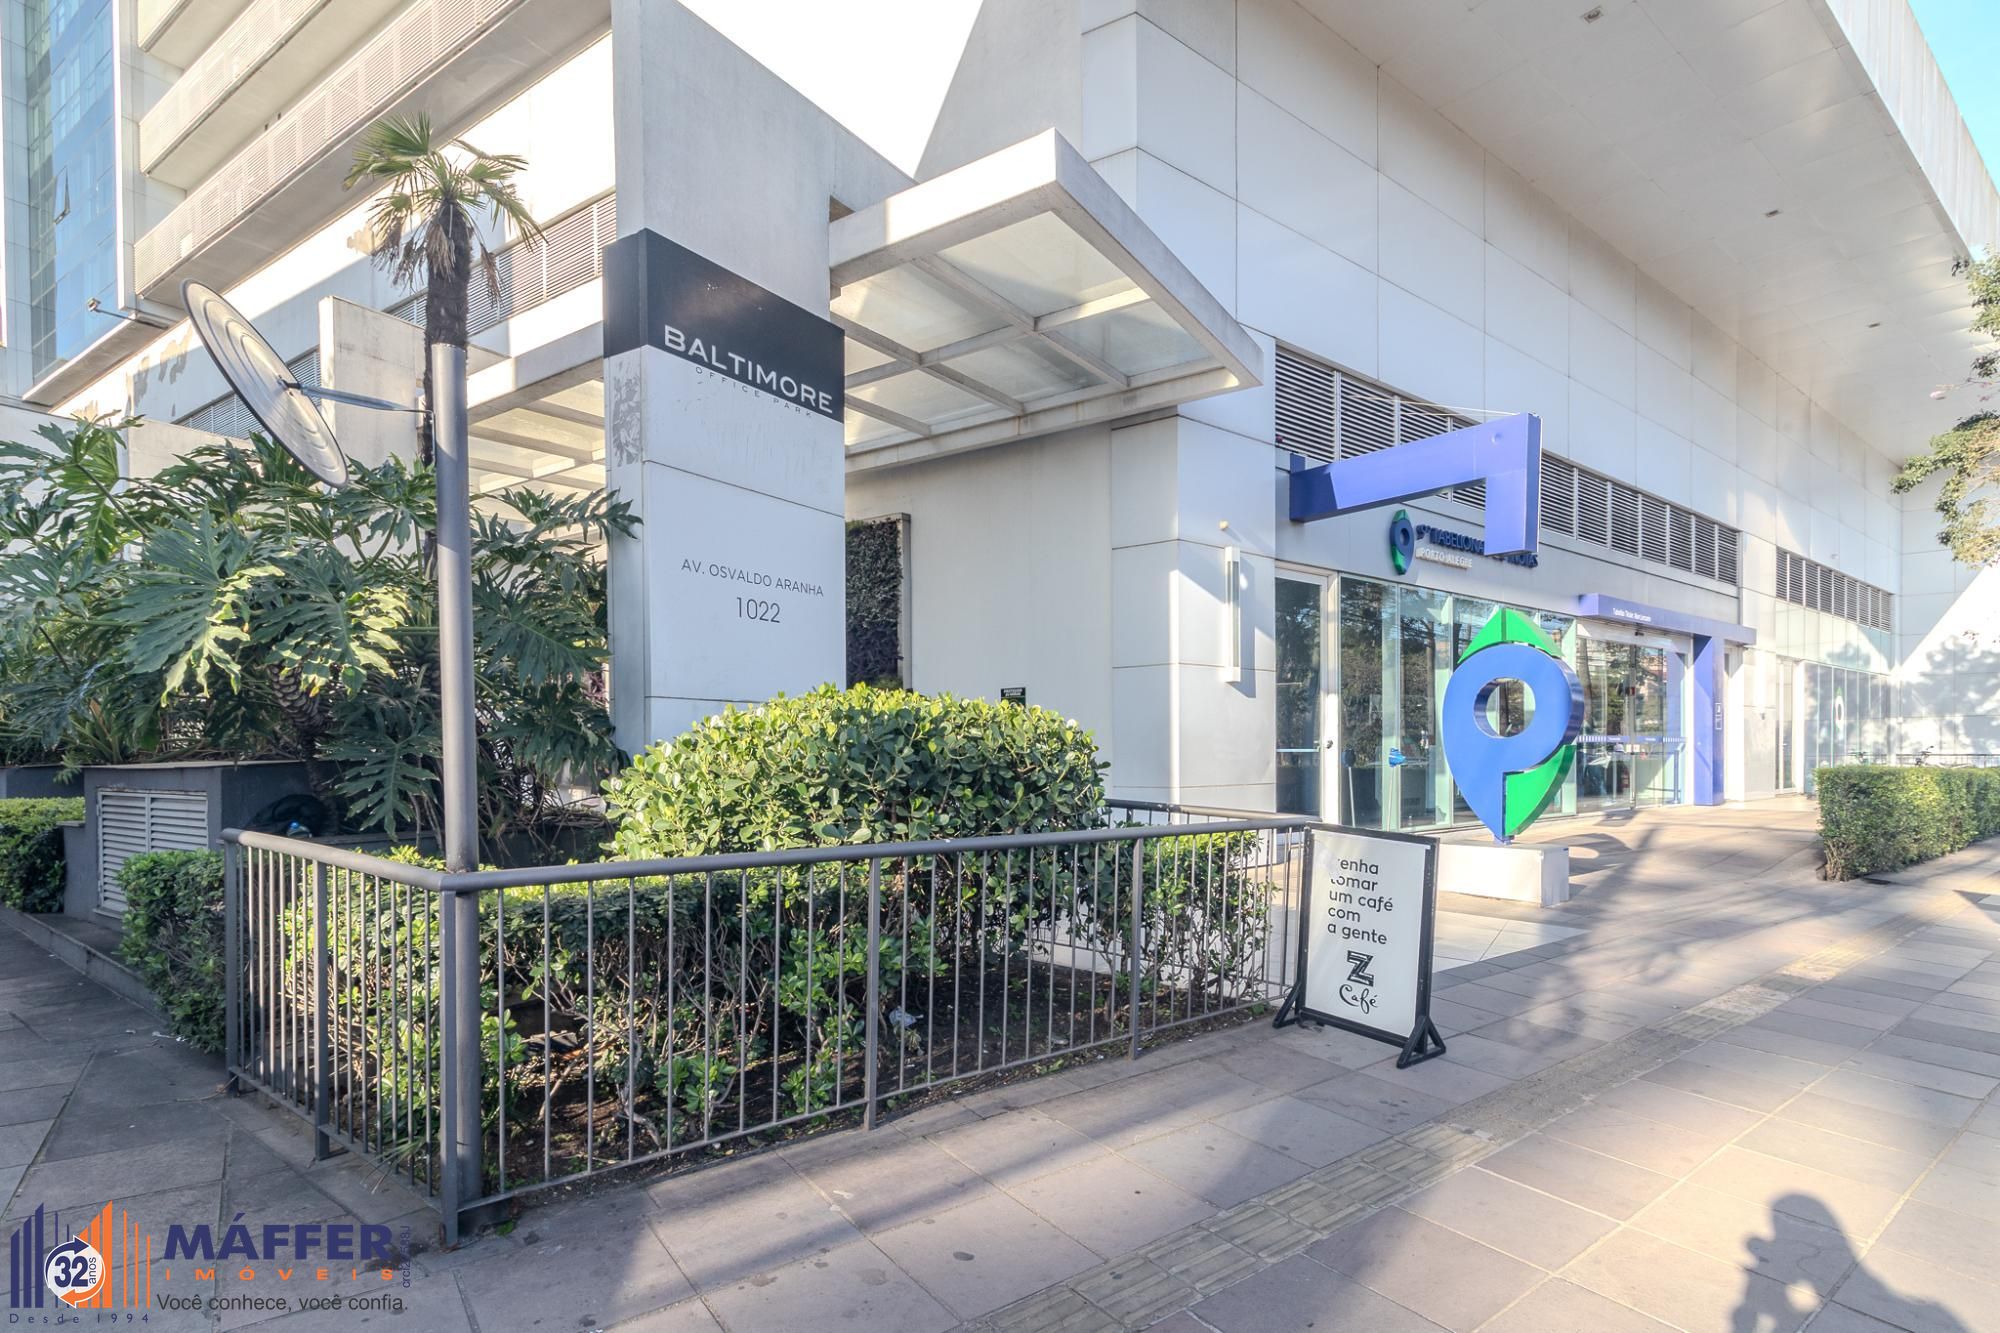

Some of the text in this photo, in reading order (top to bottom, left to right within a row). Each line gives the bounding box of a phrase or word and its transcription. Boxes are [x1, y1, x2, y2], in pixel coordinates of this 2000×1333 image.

[665, 324, 833, 414] BALTIMORE
[695, 367, 812, 419] OFFICE PARK
[1430, 527, 1485, 556] TABELIONA
[681, 558, 824, 597] AV. OSVALDO ARANHA
[736, 597, 781, 623] 1022
[1338, 858, 1379, 875] enha
[1328, 906, 1361, 922] com
[1329, 890, 1393, 912] um café
[1327, 922, 1387, 944] a gente
[1347, 950, 1374, 987] Z
[1339, 983, 1378, 1014] Café
